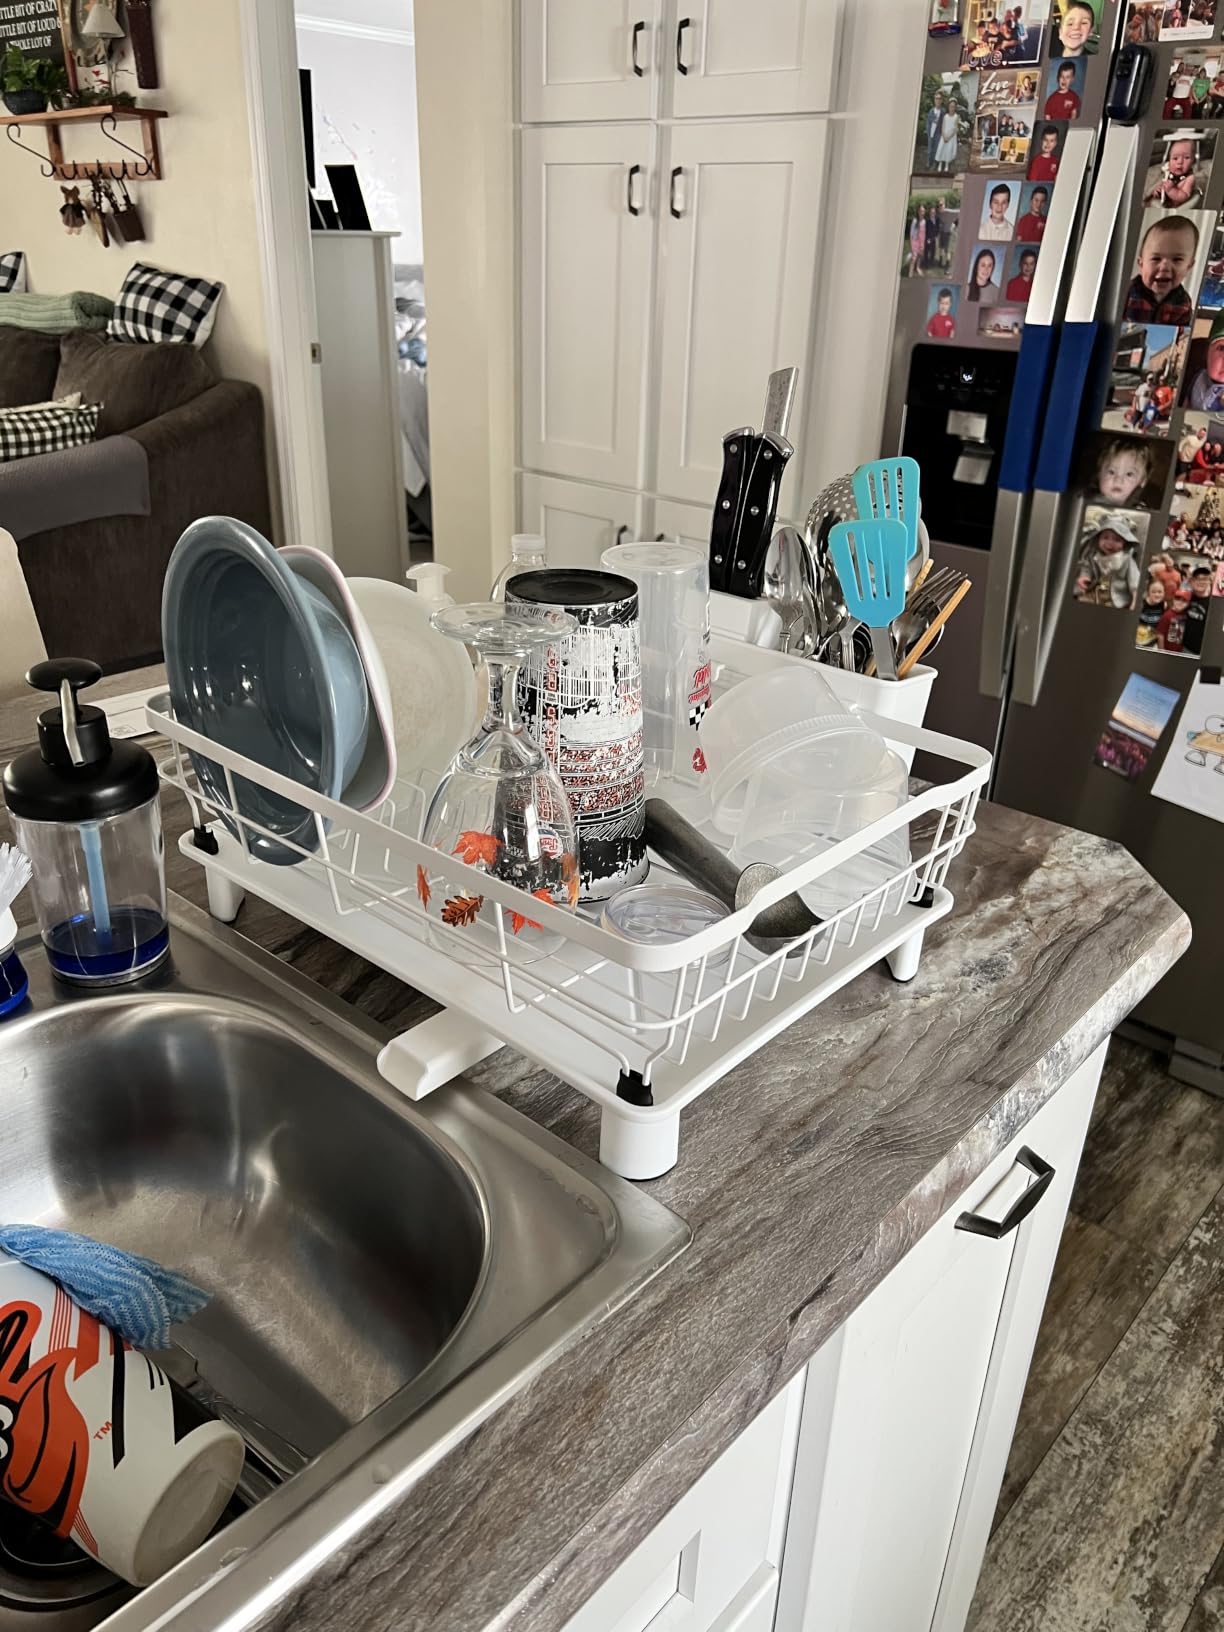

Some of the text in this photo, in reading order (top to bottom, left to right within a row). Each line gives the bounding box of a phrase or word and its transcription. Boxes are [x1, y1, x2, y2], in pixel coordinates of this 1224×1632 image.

[0, 6, 15, 20] TTLE
[15, 4, 25, 18] BIT
[26, 2, 35, 16] OF
[17, 22, 27, 35] BIT
[27, 20, 36, 33] OF
[37, 17, 57, 32] LOUD
[31, 37, 43, 49] LOT
[43, 35, 52, 47] OF
[93, 1421, 113, 1440] TM
